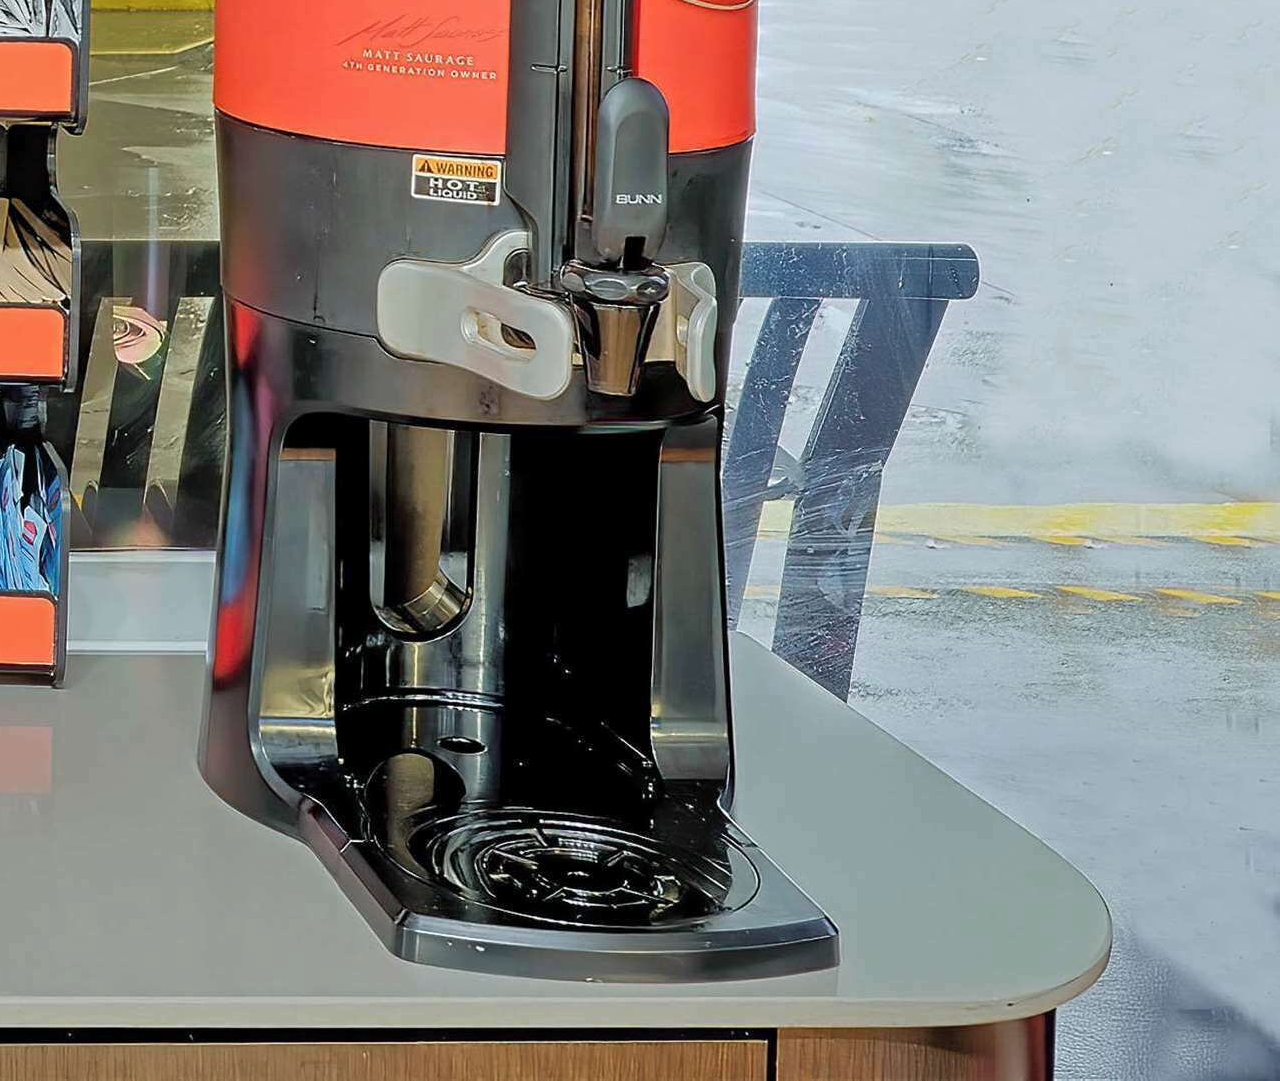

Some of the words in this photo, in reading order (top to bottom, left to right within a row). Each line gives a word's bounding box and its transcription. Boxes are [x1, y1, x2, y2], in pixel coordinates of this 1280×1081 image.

[362, 48, 402, 61] MATT
[406, 52, 475, 67] SAURAGE
[342, 60, 363, 70] 4TH
[367, 63, 446, 78] GENERATION
[450, 69, 498, 81] OWNER
[435, 161, 495, 179] WARNING
[429, 176, 480, 192] HOT
[429, 188, 478, 201] LIQUID
[615, 194, 663, 205] BUNN
